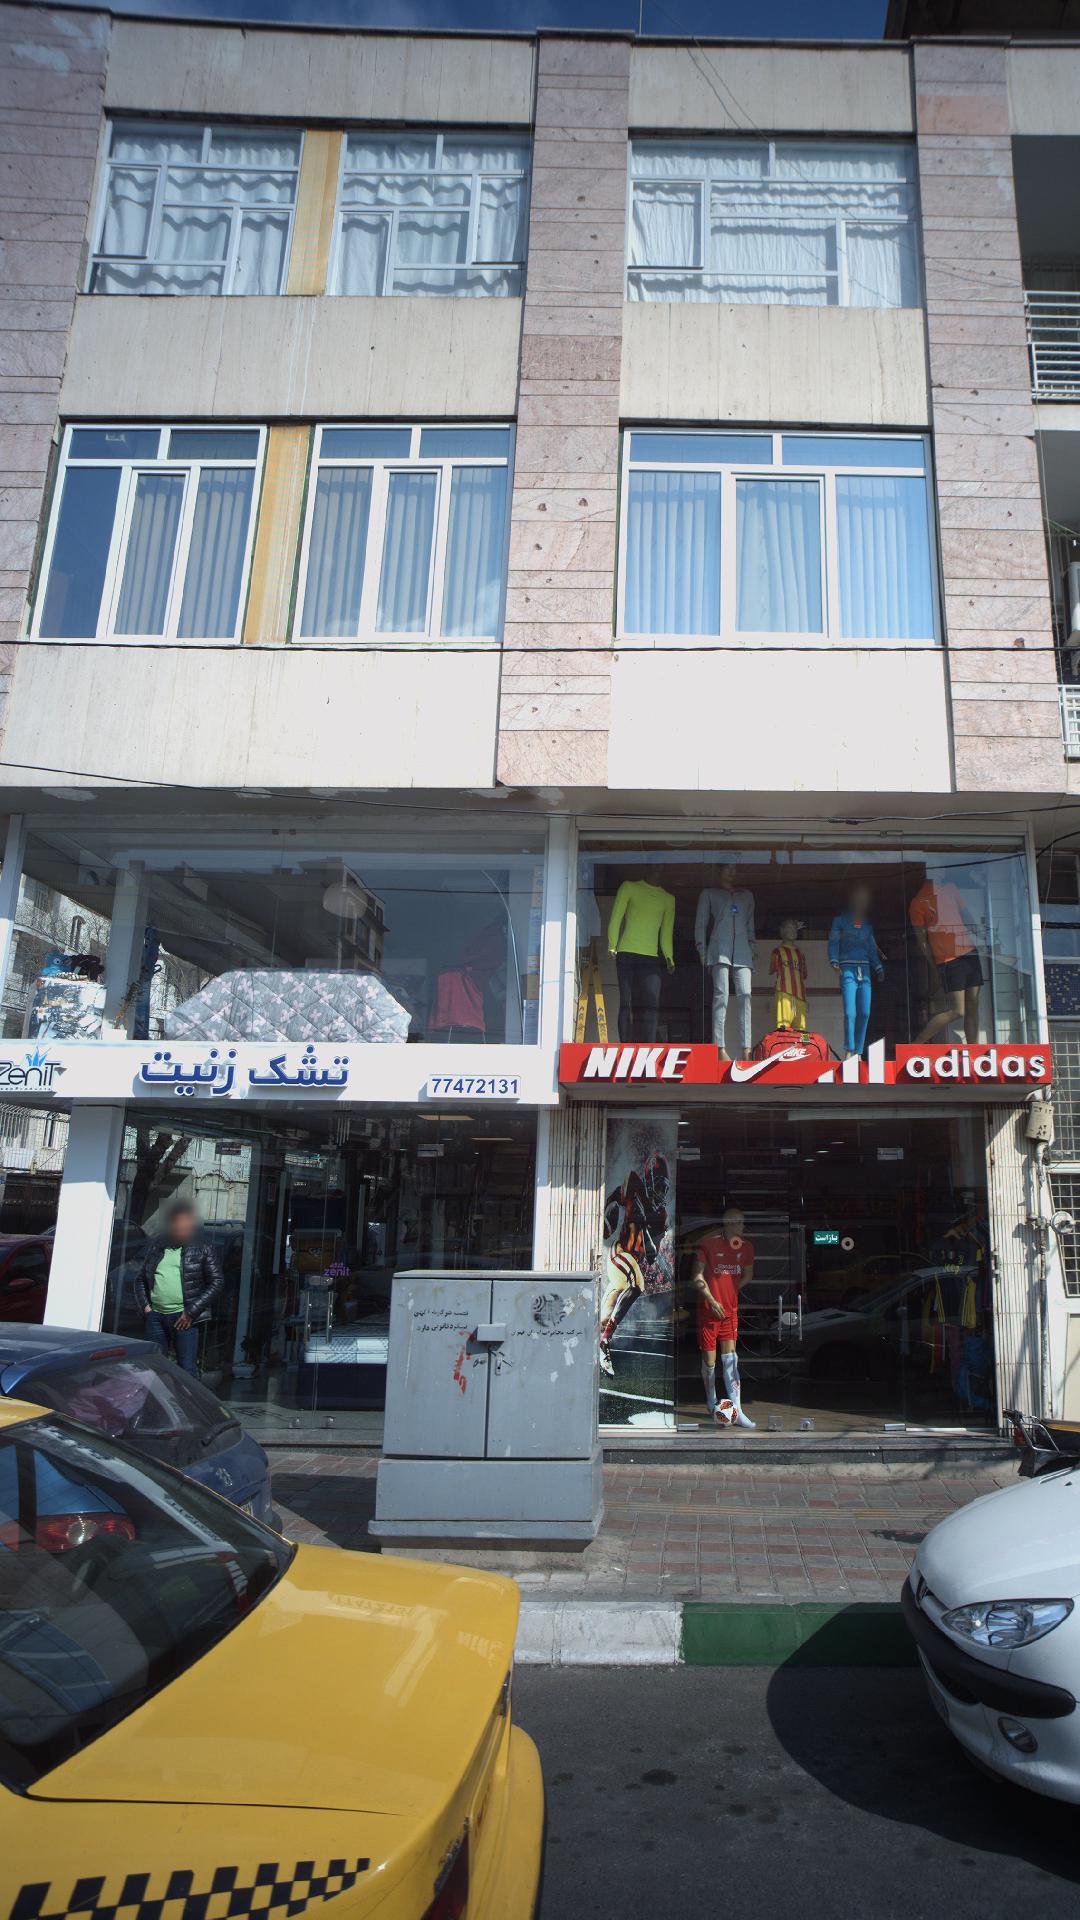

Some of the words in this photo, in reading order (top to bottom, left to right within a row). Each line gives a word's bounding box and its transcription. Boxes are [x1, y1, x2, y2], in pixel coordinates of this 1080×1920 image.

[141, 1049, 236, 1096] زنیت
[249, 1045, 349, 1085] تشک
[583, 1047, 692, 1079] NIKE
[905, 1048, 1046, 1078] adidas
[431, 1078, 518, 1094] 77472131
